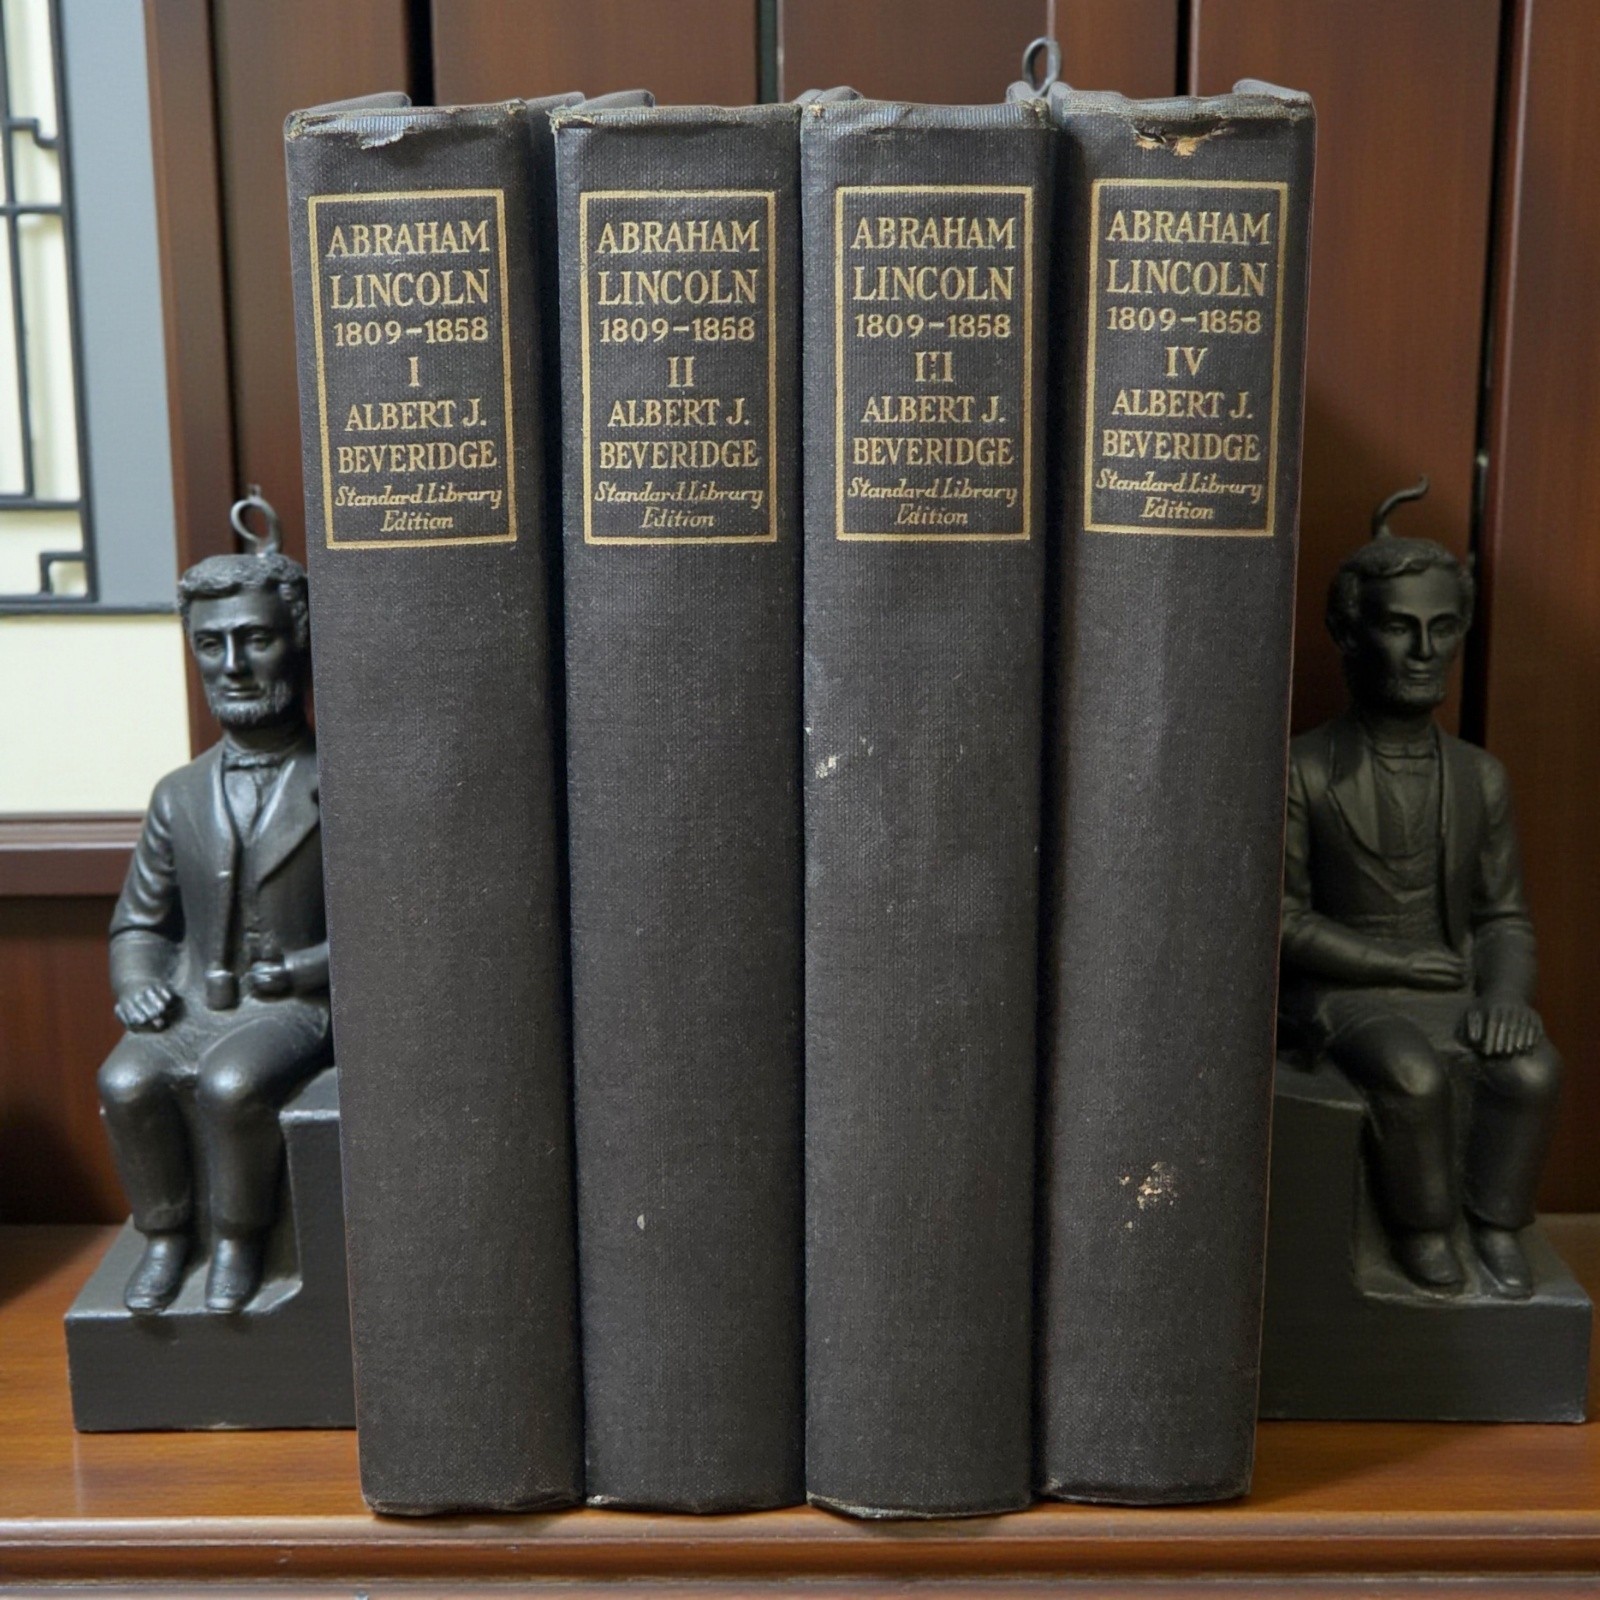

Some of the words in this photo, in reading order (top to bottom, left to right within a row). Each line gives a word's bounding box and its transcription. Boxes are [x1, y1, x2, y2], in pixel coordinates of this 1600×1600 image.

[327, 221, 490, 258] ABRAHAM
[597, 220, 759, 254] ABRAHAM
[851, 217, 1015, 250] ABRAHAM
[1106, 211, 1270, 245] ABRAHAM
[331, 269, 489, 309] LINCOLN
[598, 269, 758, 306] LINCOLN
[852, 266, 1014, 301] LINCOLN
[1106, 259, 1267, 297] LINCOLN
[334, 318, 489, 347] 1809-1858
[601, 317, 755, 342] 1809-1858
[855, 314, 1012, 338] 1809-1858
[1107, 307, 1262, 334] 1809-1858
[668, 356, 695, 388] II
[1166, 347, 1209, 377] IV
[345, 401, 457, 431] ALBERT
[463, 399, 486, 427] J.
[608, 398, 720, 427] ALBERT
[726, 398, 749, 426] J.
[861, 395, 974, 424] ALBERT
[981, 395, 1005, 423] J.
[1112, 390, 1224, 419] ALBERT
[1230, 391, 1253, 419] J.
[338, 440, 497, 474] BEVERIDGE
[600, 440, 759, 469] BEVERIDGE
[853, 437, 1014, 466] BEVERIDGE
[1103, 429, 1261, 461] BEVERIDGE
[335, 485, 421, 507] Standard
[426, 482, 502, 509] Library
[595, 481, 684, 502] Standard
[689, 481, 763, 509] Library
[848, 477, 938, 498] Standard
[941, 477, 1017, 506] Library
[1096, 469, 1187, 492] Standard
[1189, 472, 1262, 505] Library
[380, 511, 454, 532] Edition
[642, 507, 715, 529] Edition
[894, 504, 968, 525] Edition
[1141, 497, 1214, 520] Edition
